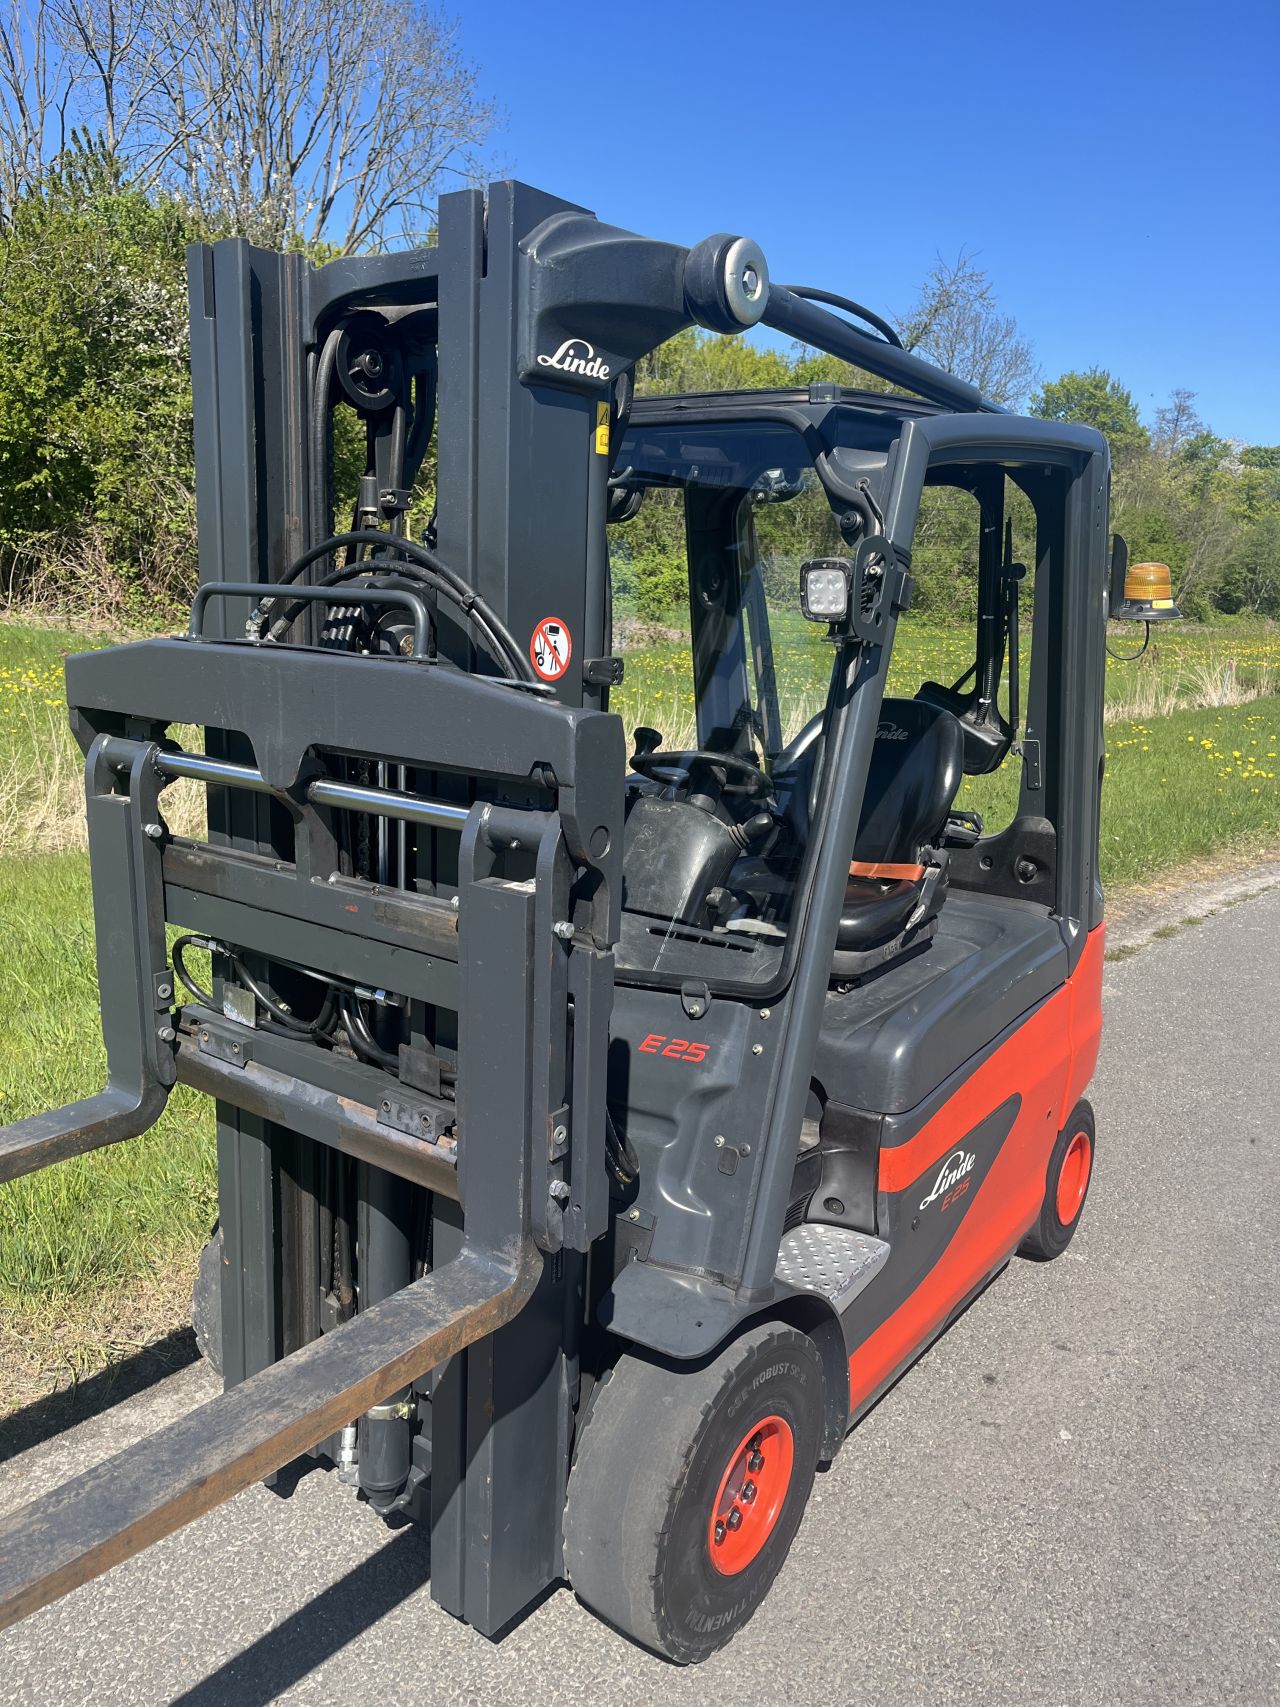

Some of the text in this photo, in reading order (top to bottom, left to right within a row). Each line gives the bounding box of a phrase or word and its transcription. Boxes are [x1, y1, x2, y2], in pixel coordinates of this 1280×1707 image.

[537, 338, 610, 380] Linde
[876, 721, 909, 740] nde
[919, 1150, 976, 1211] Linde
[752, 1361, 790, 1391] ROBUST
